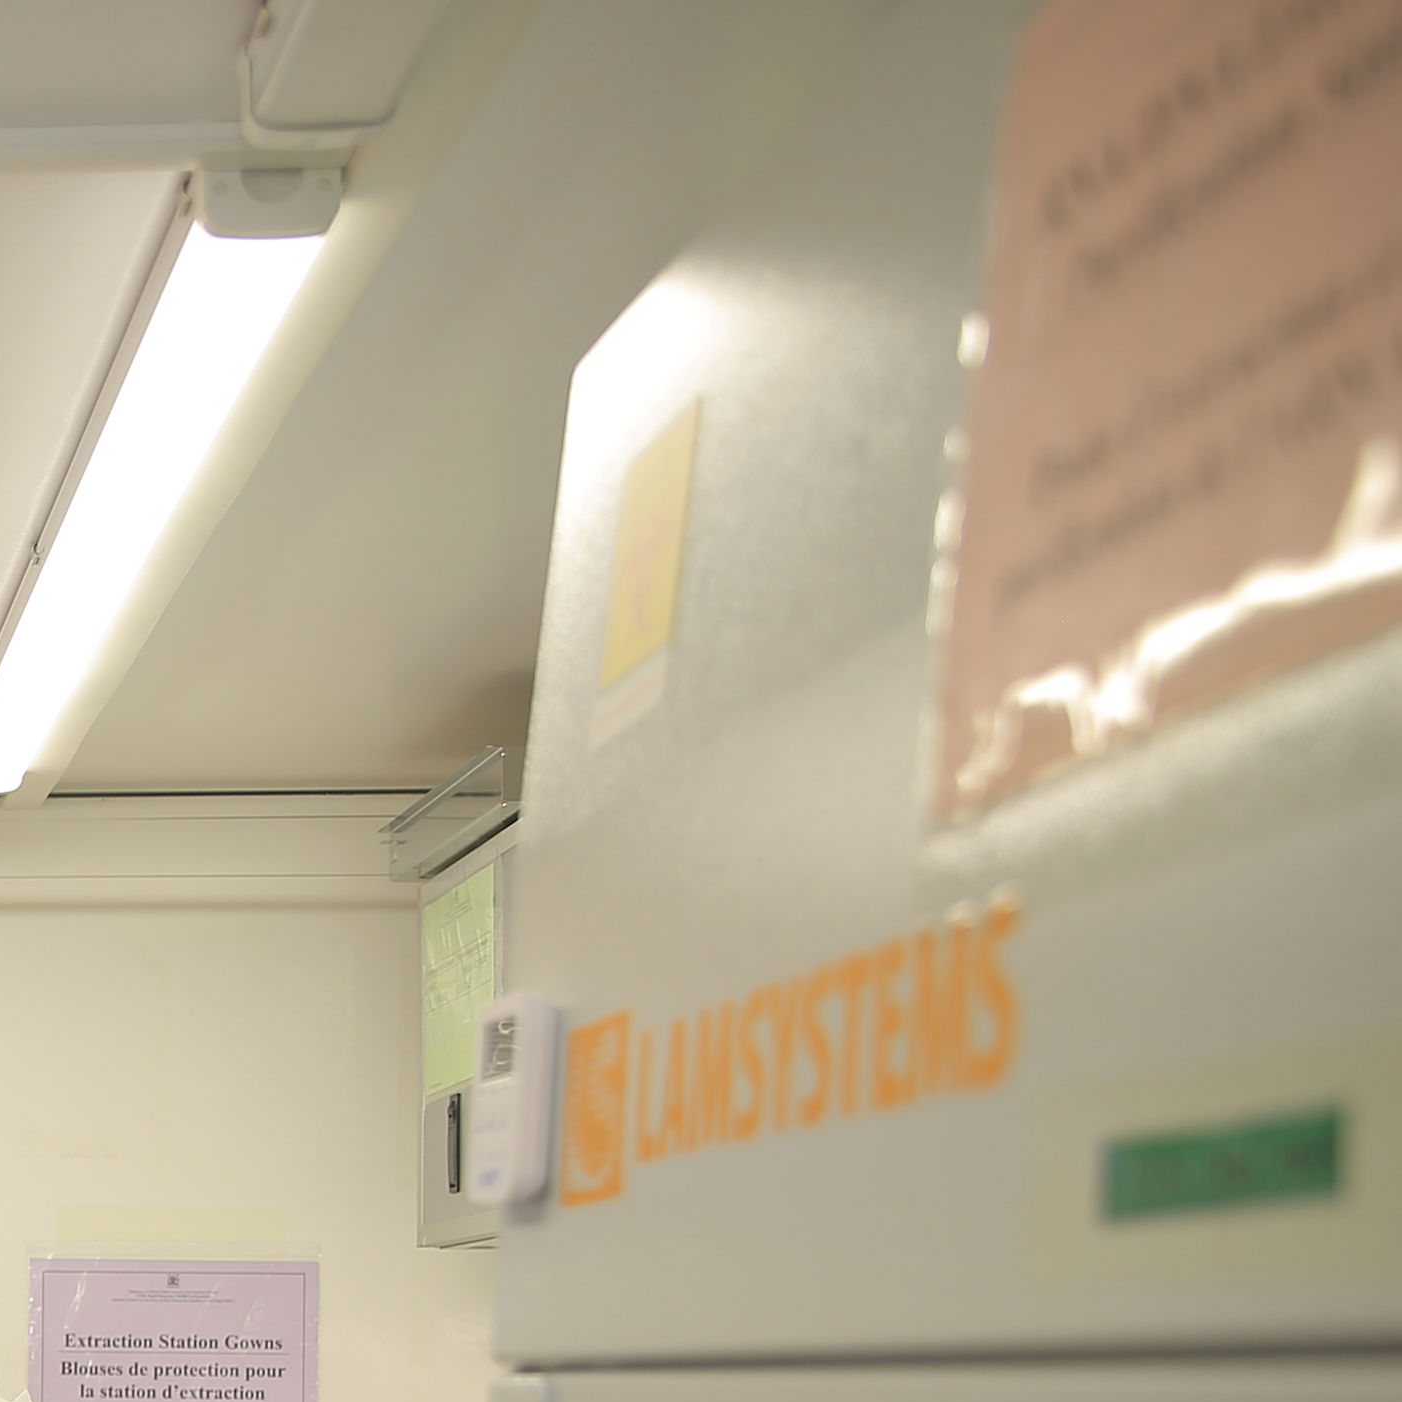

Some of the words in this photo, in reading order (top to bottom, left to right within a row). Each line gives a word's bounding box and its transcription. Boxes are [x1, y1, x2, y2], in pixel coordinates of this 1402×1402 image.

[634, 902, 1022, 1164] LAMSYSTEMS
[64, 1333, 153, 1350] Extraction
[159, 1334, 219, 1350] Station
[225, 1335, 283, 1350] Gowns
[61, 1361, 123, 1377] Blouses
[128, 1361, 148, 1377] de
[154, 1360, 240, 1380] protection
[245, 1364, 287, 1381] pour
[80, 1384, 95, 1399] la
[99, 1384, 156, 1400] station
[162, 1384, 265, 1401] d'extraction
